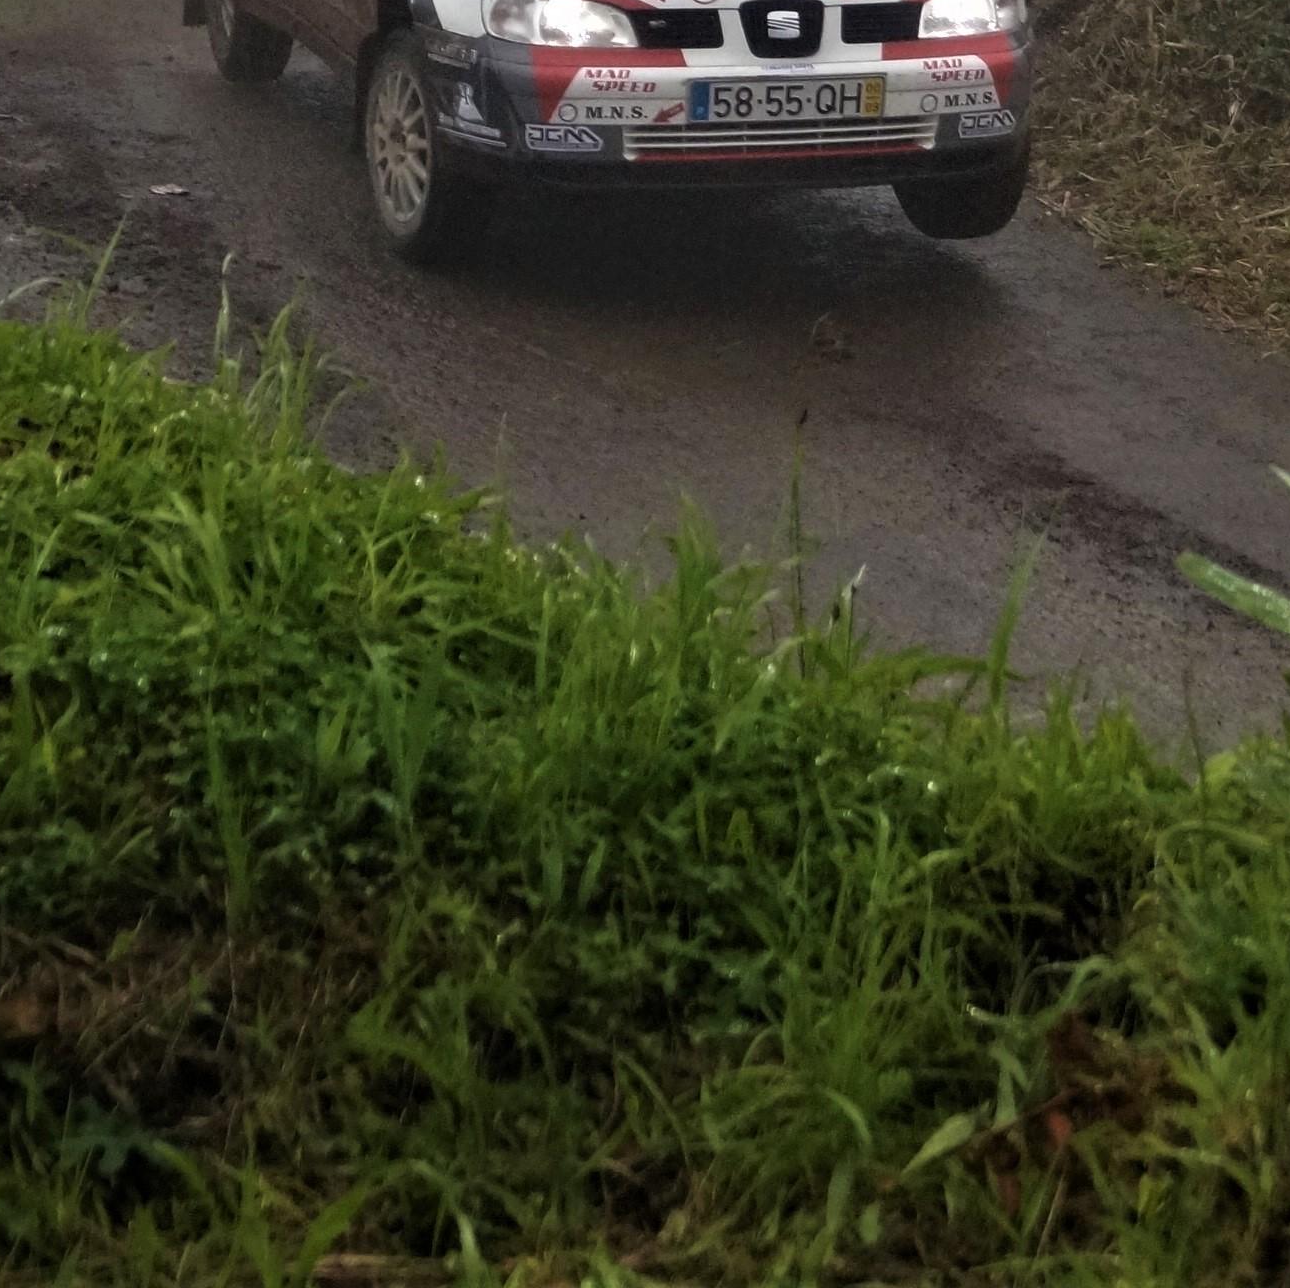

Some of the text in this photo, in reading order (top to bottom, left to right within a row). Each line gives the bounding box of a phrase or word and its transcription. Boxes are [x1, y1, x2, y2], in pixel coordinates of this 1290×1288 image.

[922, 58, 963, 71] MAD
[583, 69, 631, 79] MAD
[931, 69, 986, 83] SPEED
[591, 80, 658, 93] SPEED
[944, 91, 997, 108] M.N.S.
[585, 106, 648, 120] M.N.S.
